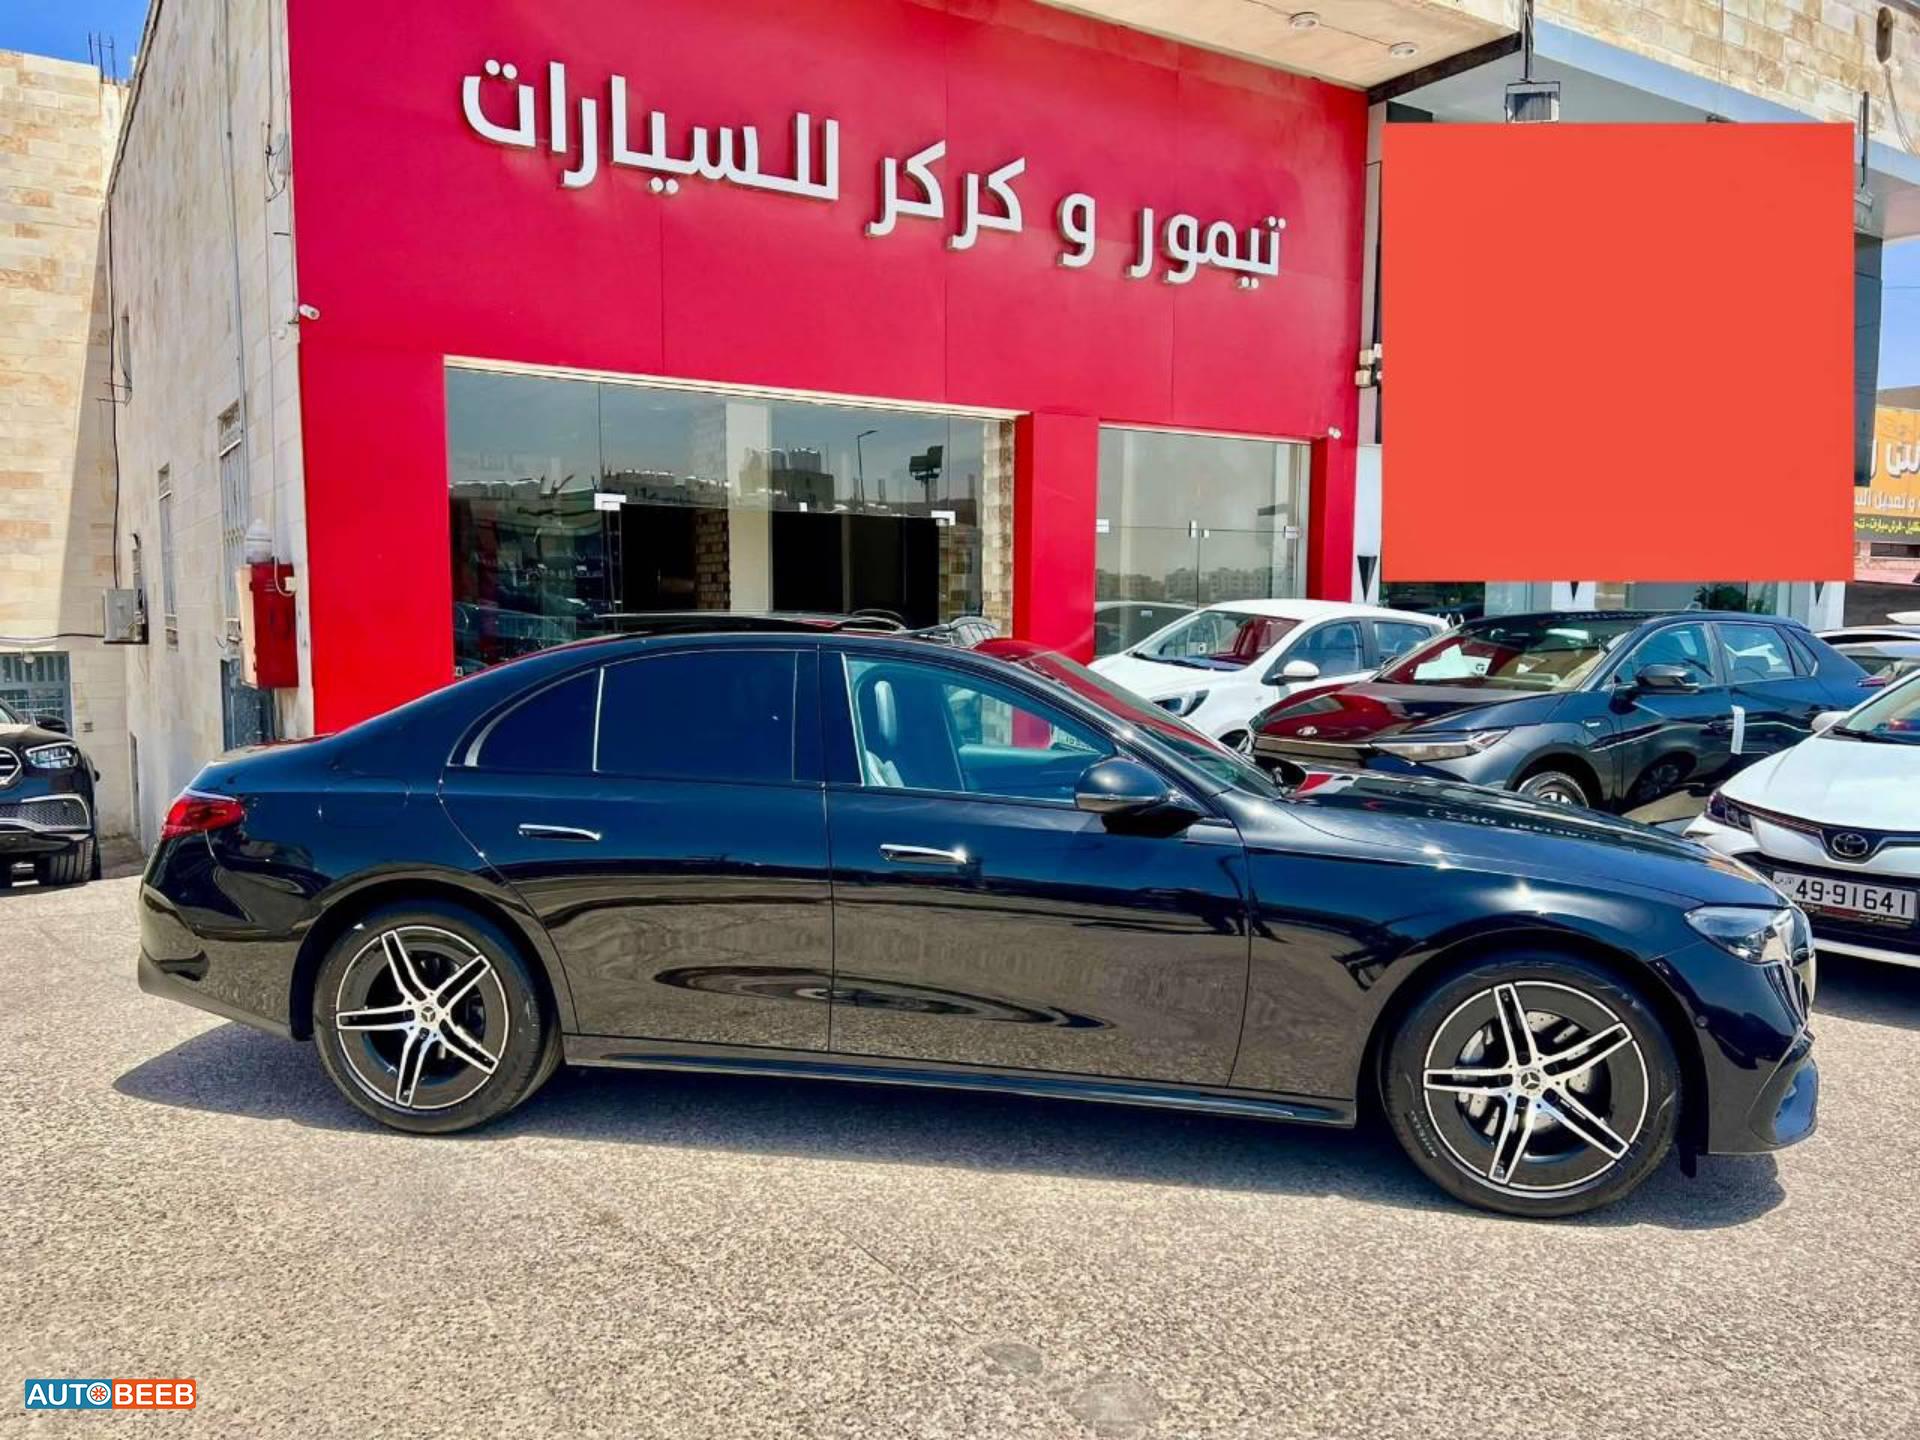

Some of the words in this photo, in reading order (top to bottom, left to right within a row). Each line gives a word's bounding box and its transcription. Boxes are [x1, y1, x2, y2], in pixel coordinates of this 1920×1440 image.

[462, 59, 840, 200] للسيارات
[866, 141, 1026, 251] كركر
[1058, 192, 1099, 269] و
[1127, 207, 1287, 291] تيمور
[1796, 878, 1906, 916] 49-91641
